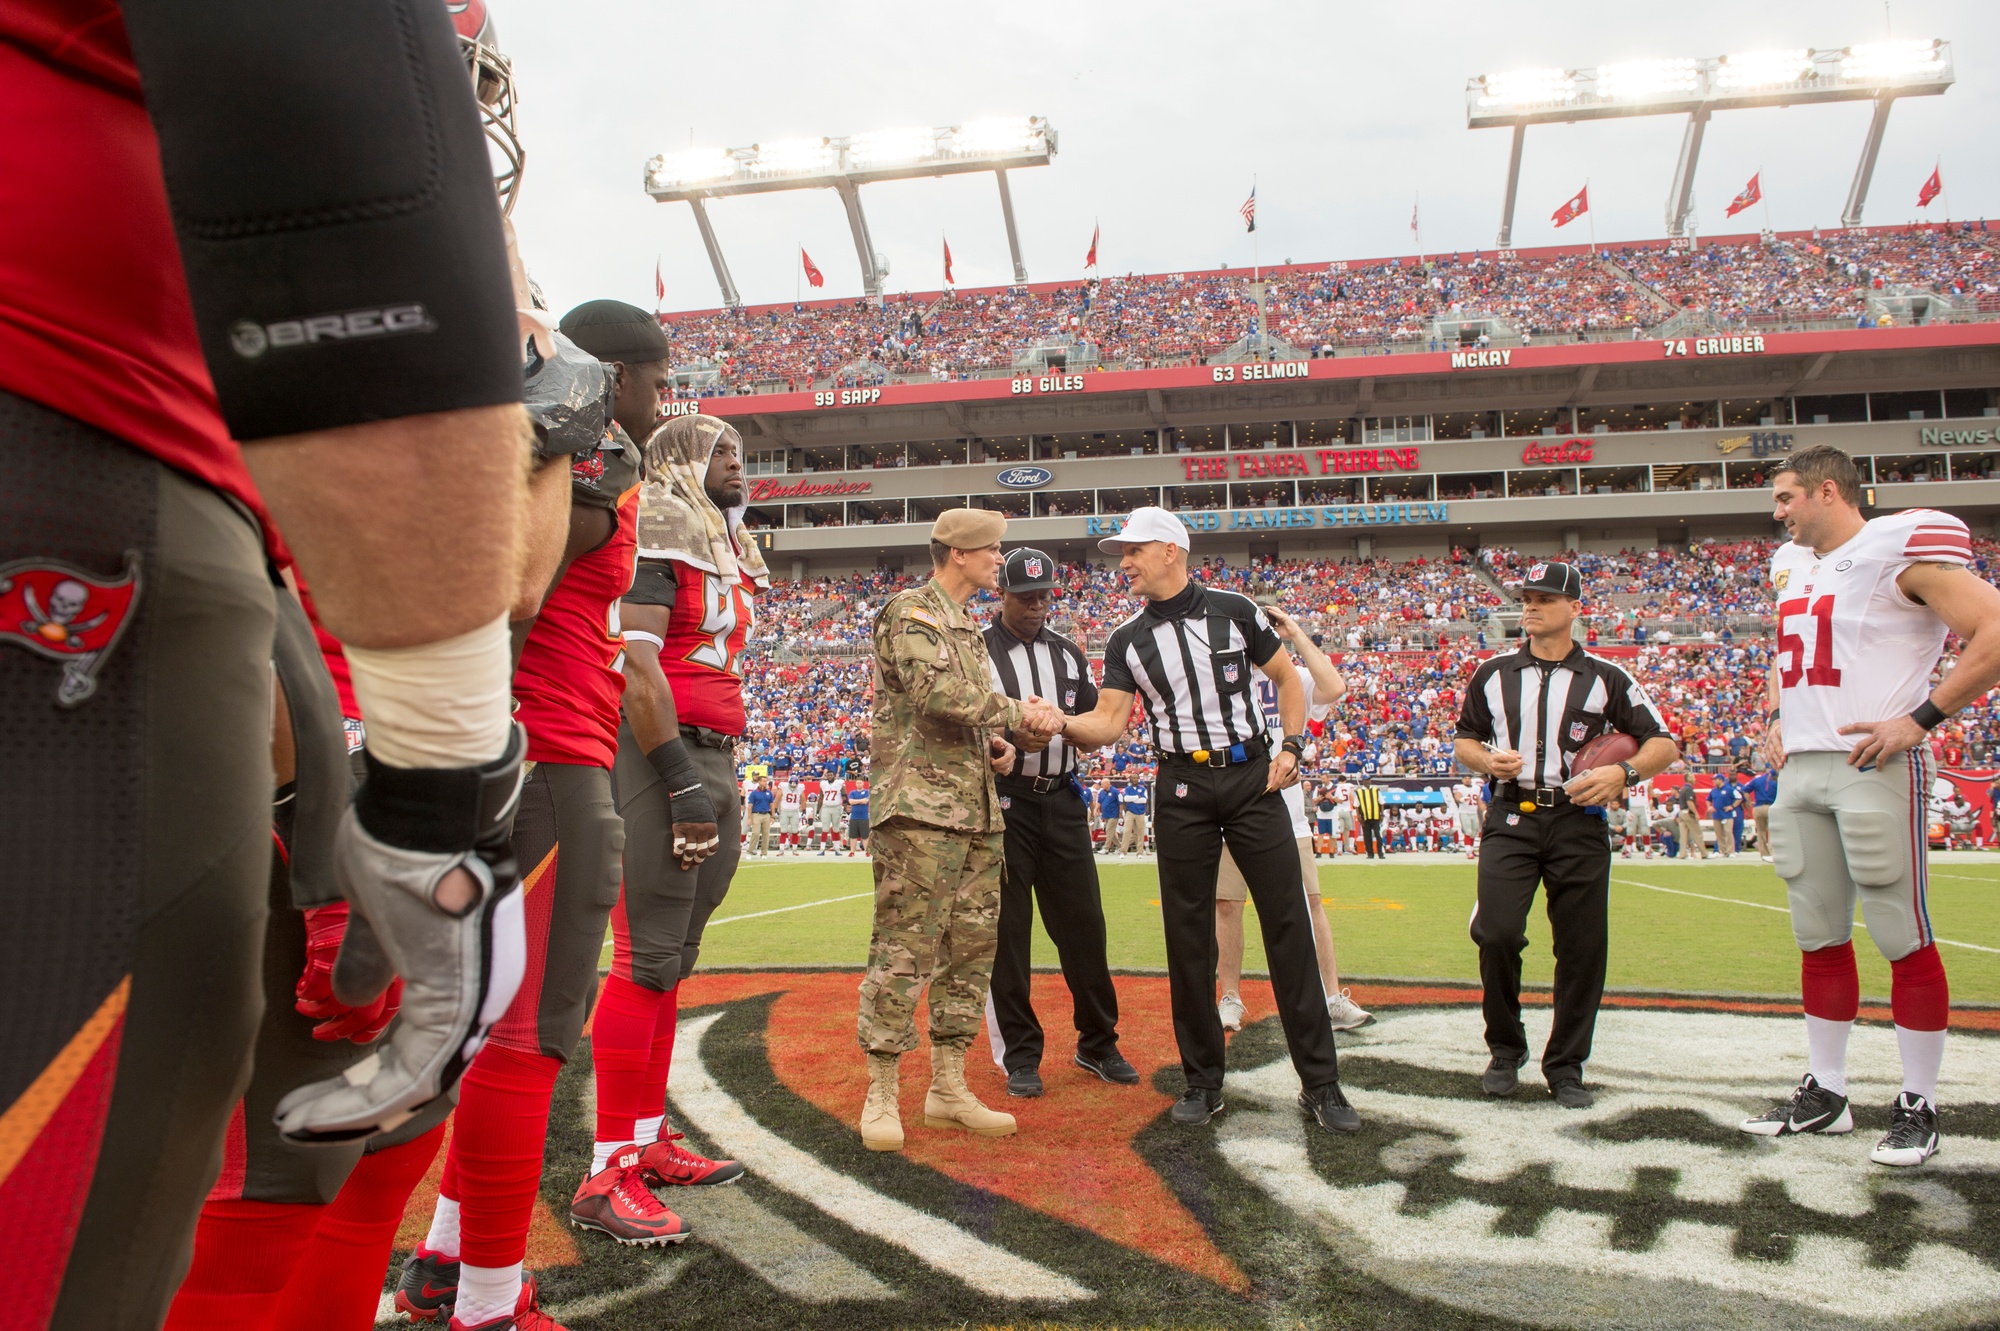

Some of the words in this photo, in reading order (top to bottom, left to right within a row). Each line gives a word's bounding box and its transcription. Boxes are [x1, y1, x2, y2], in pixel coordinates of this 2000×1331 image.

[266, 304, 424, 347] BREG
[1663, 340, 1687, 357] 74
[1696, 336, 1765, 355] GRUBER
[1213, 366, 1235, 382] 63
[1242, 361, 1309, 381] SELMON
[1011, 378, 1032, 394] 88
[1039, 375, 1084, 392] GILES
[815, 391, 835, 407] 99
[841, 388, 881, 405] SAPP
[1181, 455, 1229, 480] THE
[1233, 453, 1309, 478] TAMPA
[1316, 447, 1420, 474] TRIBUNE
[1006, 468, 1041, 484] Ford
[747, 477, 873, 501] Budweiser
[1228, 507, 1316, 530] JAMES
[1322, 503, 1448, 527] STADIUM
[1777, 594, 1842, 689] 51
[344, 731, 361, 748] FL
[785, 793, 798, 803] 61
[825, 789, 838, 801] 77
[1630, 785, 1645, 797] 94
[619, 1152, 639, 1169] GM
